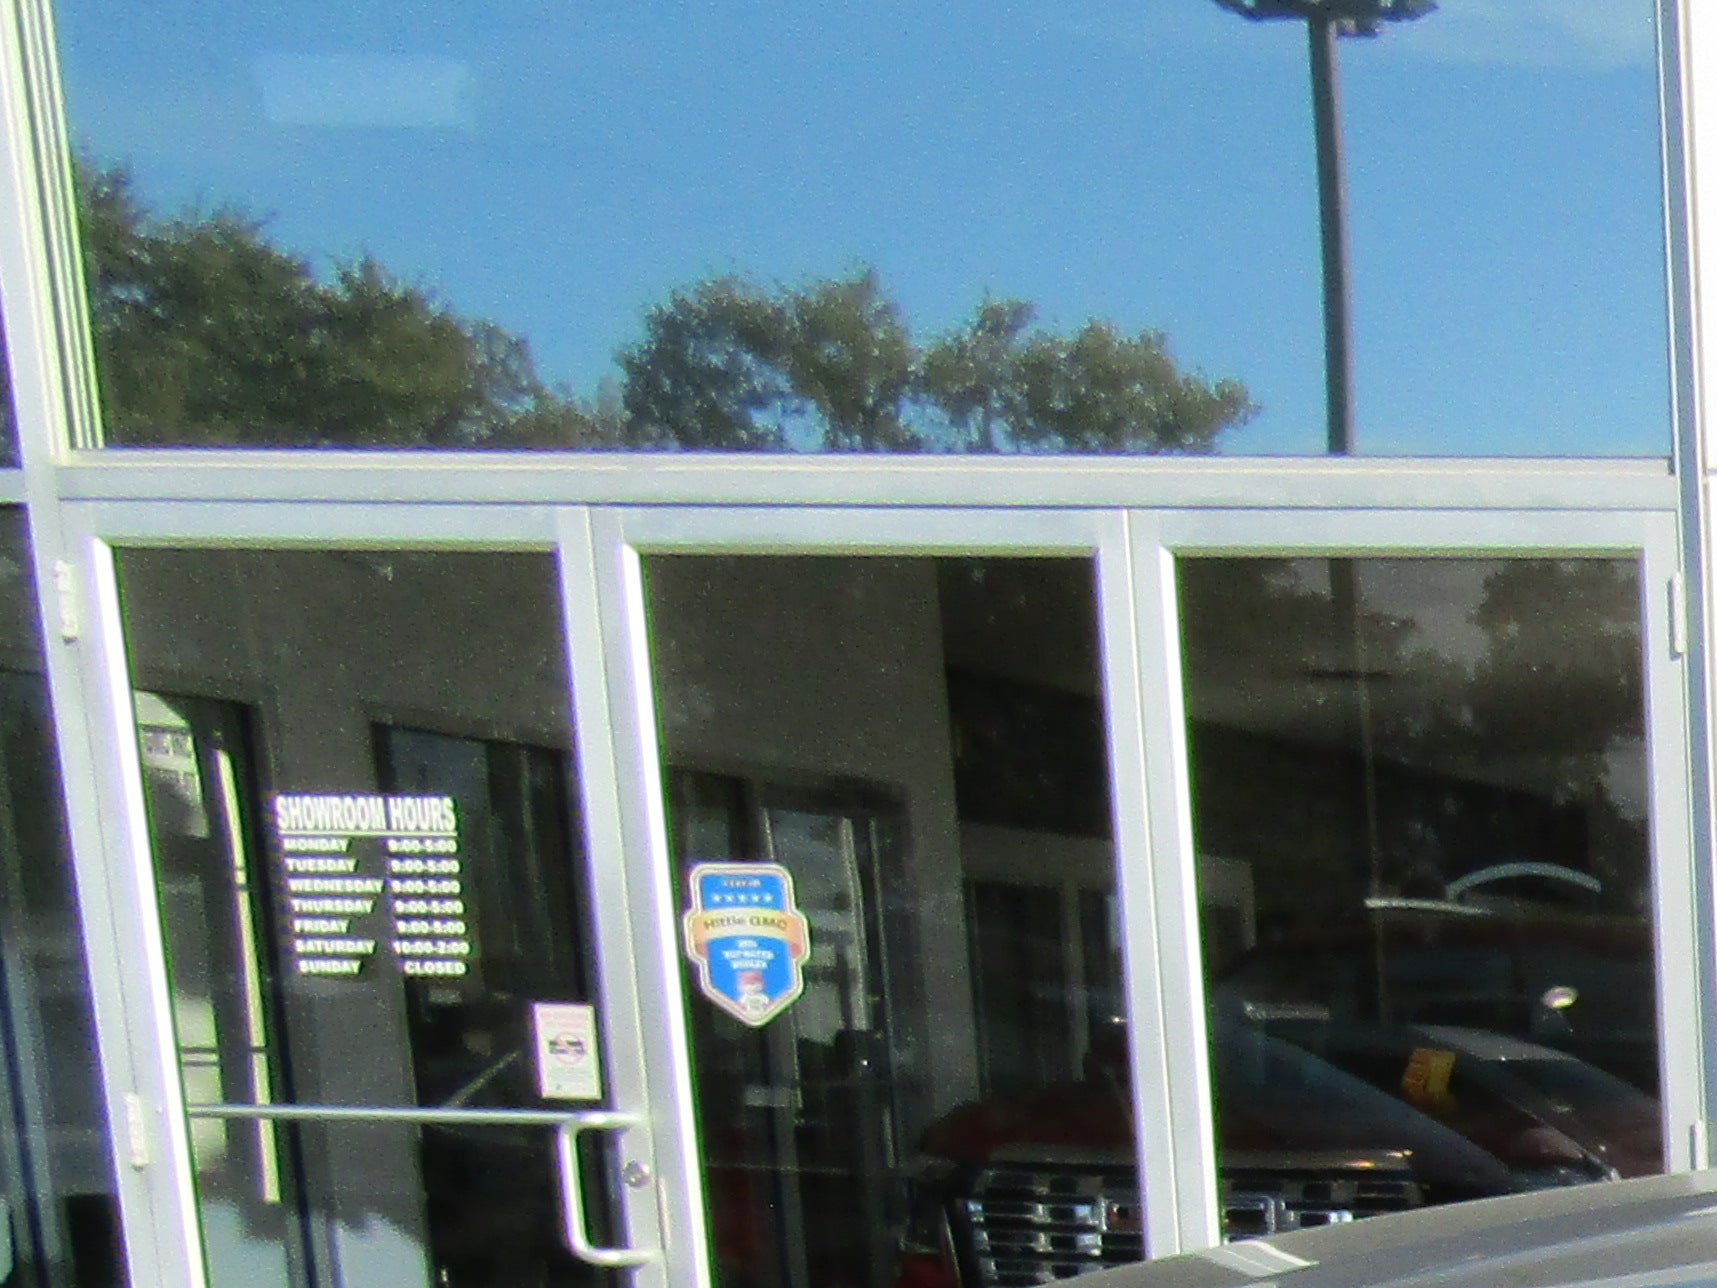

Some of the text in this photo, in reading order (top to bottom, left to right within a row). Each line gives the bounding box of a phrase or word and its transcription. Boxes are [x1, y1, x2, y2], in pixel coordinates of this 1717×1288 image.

[275, 795, 457, 832] SHOWROOM HOURS
[283, 838, 350, 852] MONDAY
[286, 857, 358, 873] TUESDAY
[288, 878, 384, 893] WEDNESDAY
[291, 898, 374, 913] THURSDAY
[293, 918, 350, 933] FRIDAY
[294, 939, 376, 954] SATURDAY
[299, 958, 467, 976] SUNDAY CLOSED
